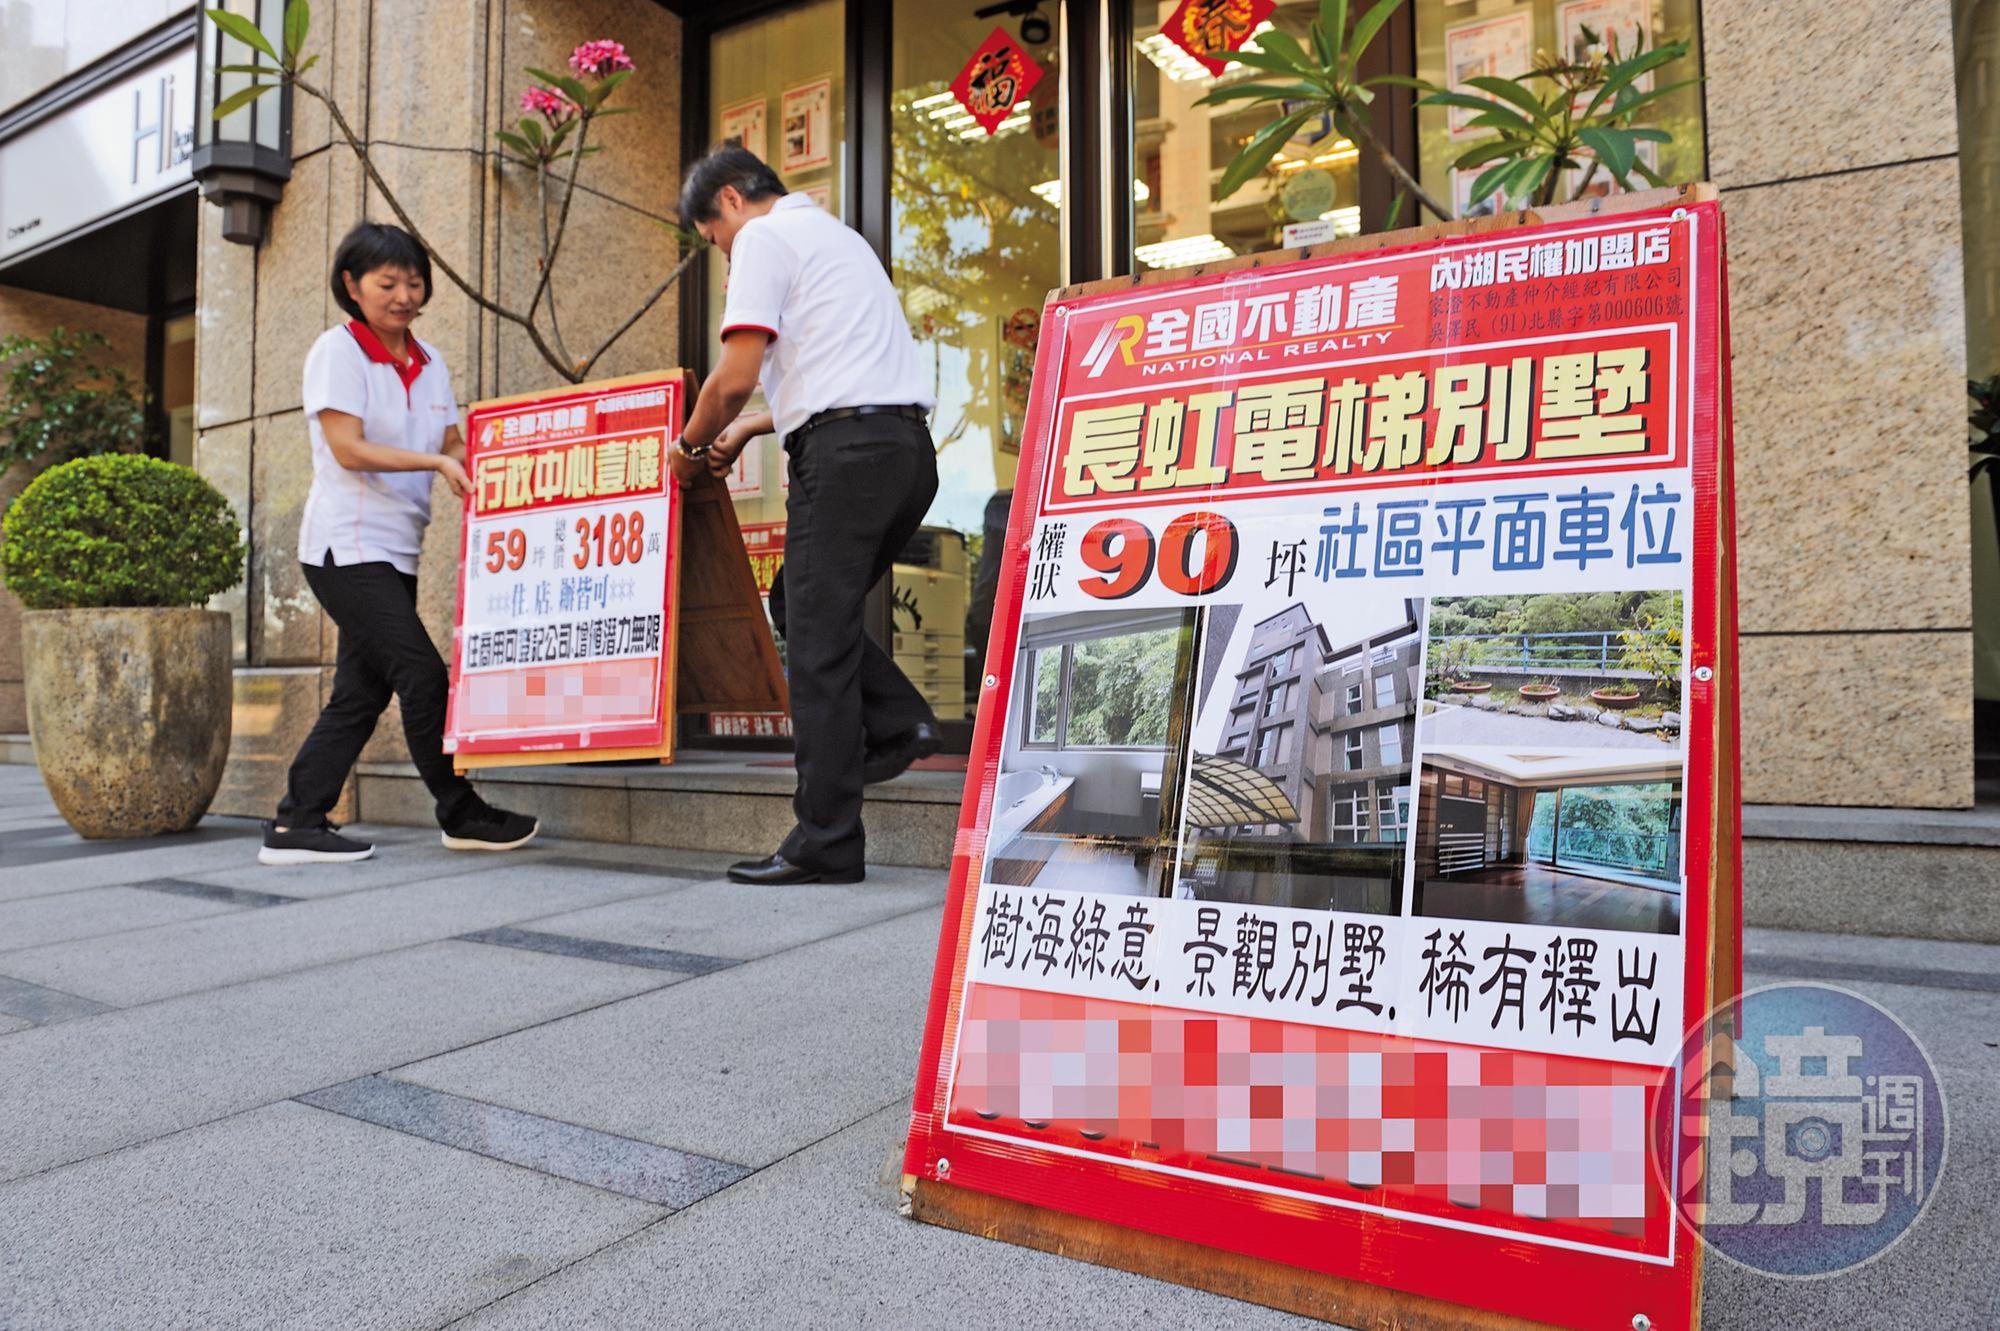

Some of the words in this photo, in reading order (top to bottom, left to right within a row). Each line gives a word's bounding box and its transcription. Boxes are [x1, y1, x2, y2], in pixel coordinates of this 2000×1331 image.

[969, 46, 1016, 112] 福
[1429, 228, 1671, 292] 內湖民權加盟店
[1143, 275, 1400, 358] 全國不動產
[1142, 351, 1271, 377] NATIONAL
[1283, 331, 1393, 357] REALTY
[1063, 345, 1652, 497] 長虹電梯別墅
[476, 435, 661, 513] 行政中心壹樓
[486, 528, 527, 574] 59
[573, 510, 645, 570] 3188
[1078, 511, 1240, 600] 90
[1264, 539, 1306, 597] 坪
[1314, 482, 1682, 583] 社區平面車位
